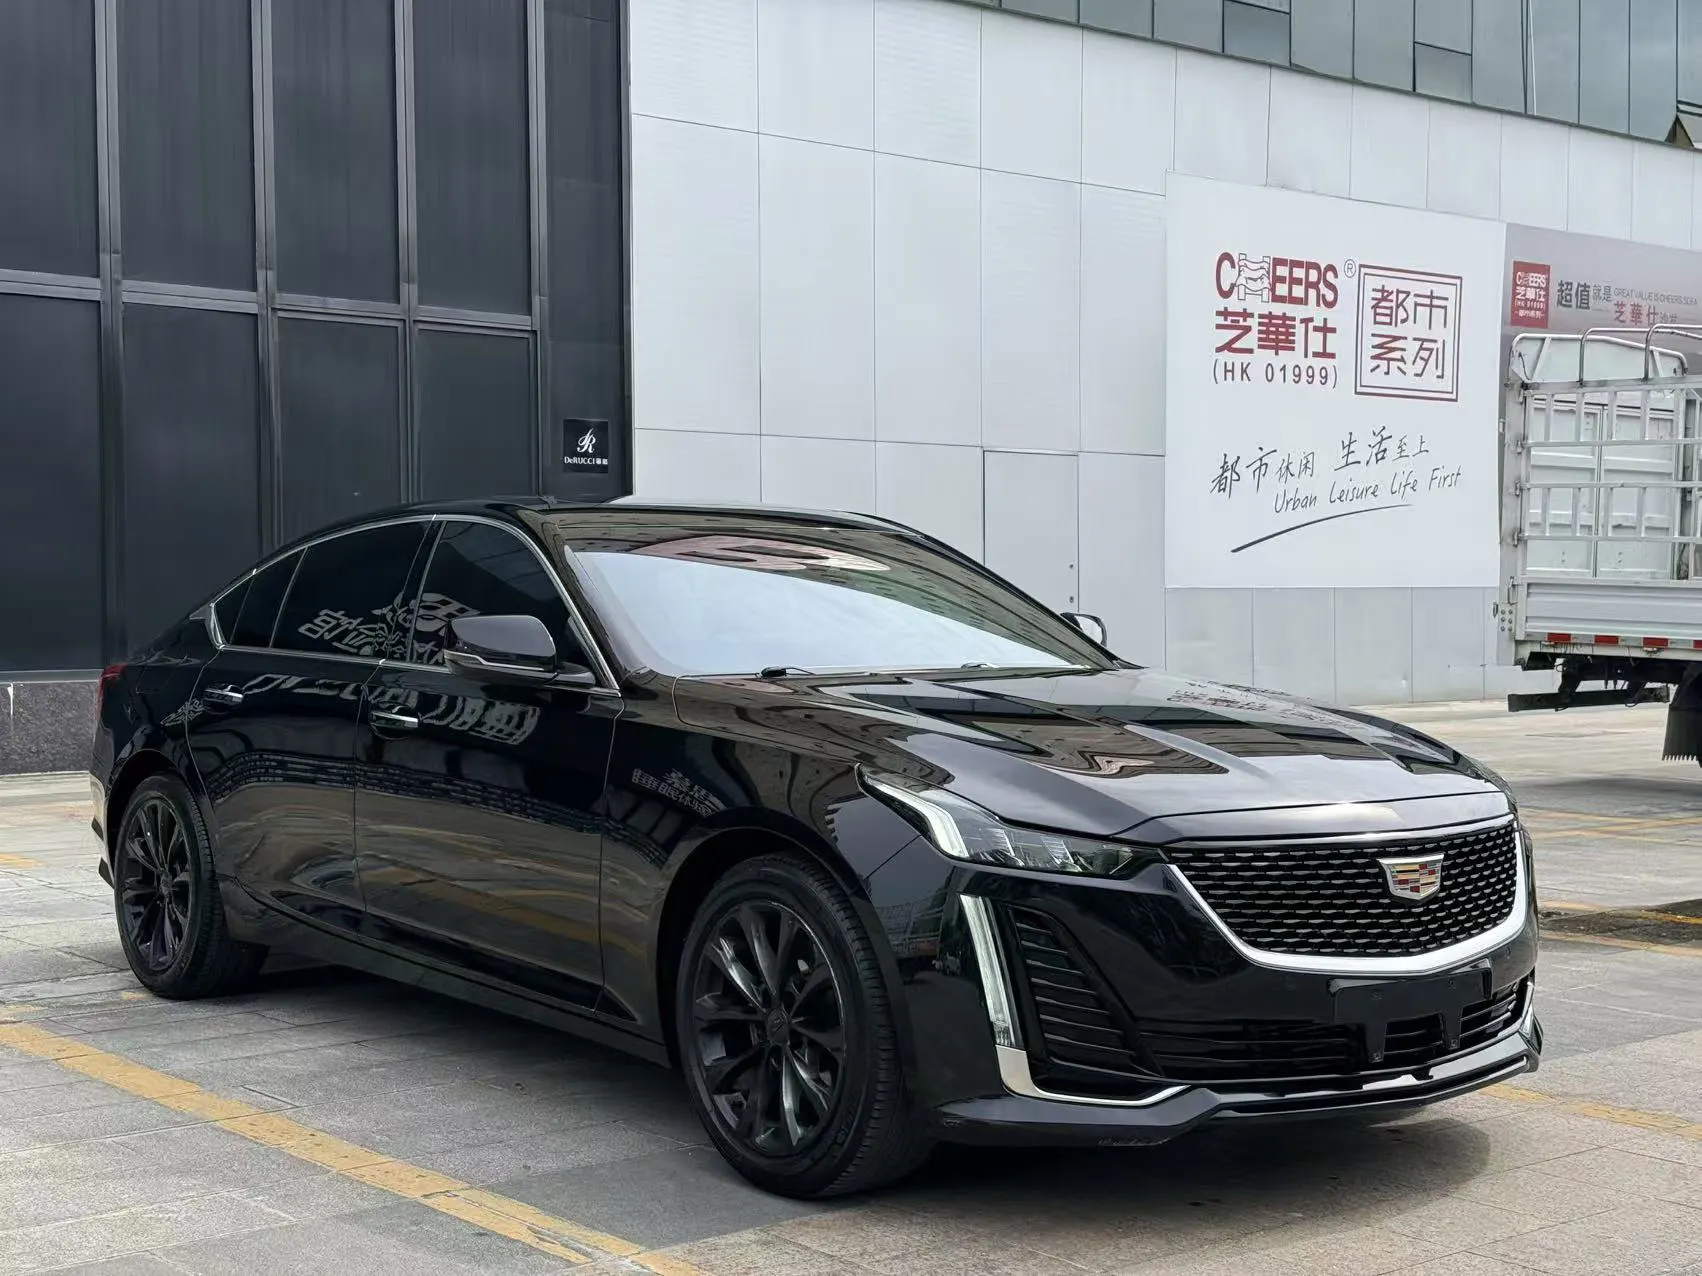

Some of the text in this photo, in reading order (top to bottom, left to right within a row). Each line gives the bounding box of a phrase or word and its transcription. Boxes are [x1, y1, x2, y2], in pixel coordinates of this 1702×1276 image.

[1215, 252, 1339, 309] CHEERS
[1370, 284, 1449, 331] 都市
[1215, 306, 1338, 359] 芝華仕
[1370, 333, 1446, 379] 系列
[1265, 362, 1338, 389] 01999)
[1210, 426, 1430, 499] 都市休闲 生活至上
[1274, 465, 1462, 513] Urban Leisure Life First
